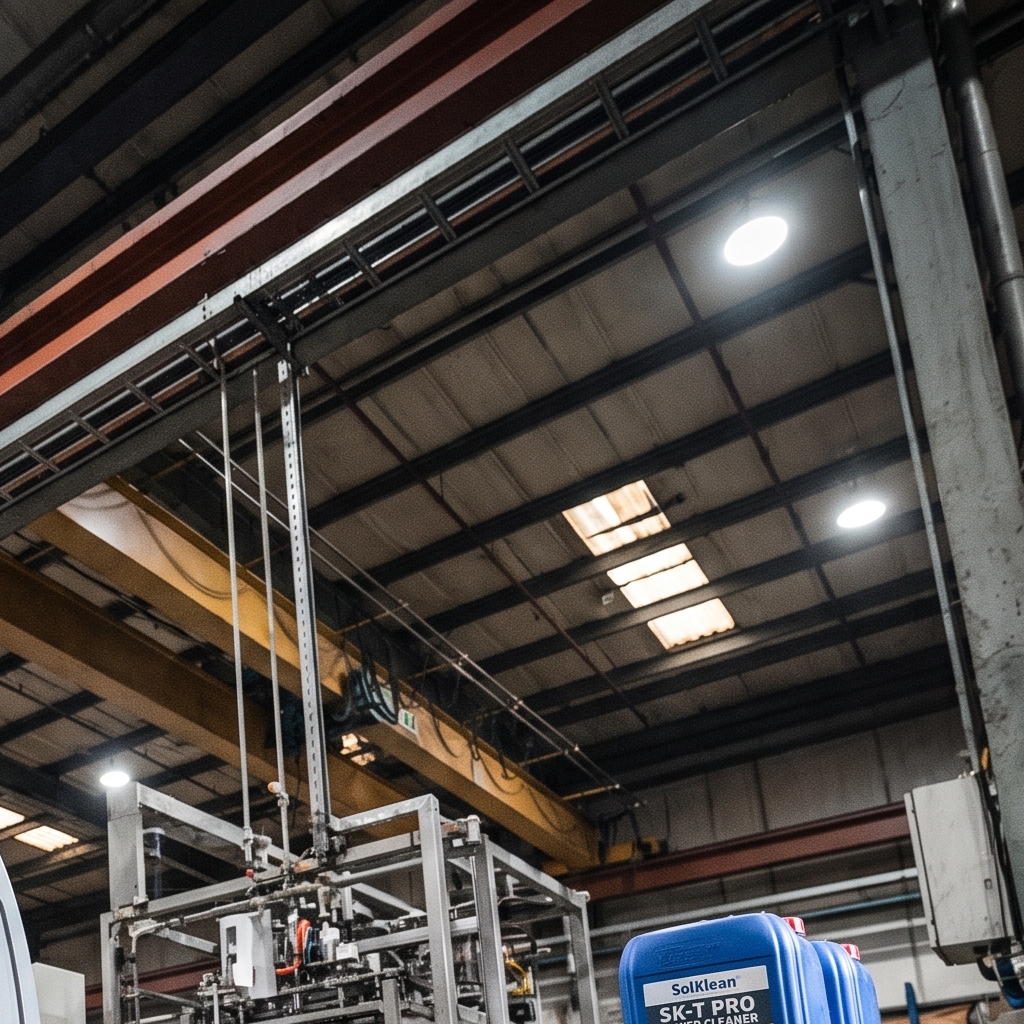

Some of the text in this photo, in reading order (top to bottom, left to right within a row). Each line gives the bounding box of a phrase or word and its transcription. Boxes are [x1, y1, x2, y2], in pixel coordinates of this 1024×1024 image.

[671, 978, 737, 996] SolKlean
[659, 995, 755, 1023] SK-T PRO
